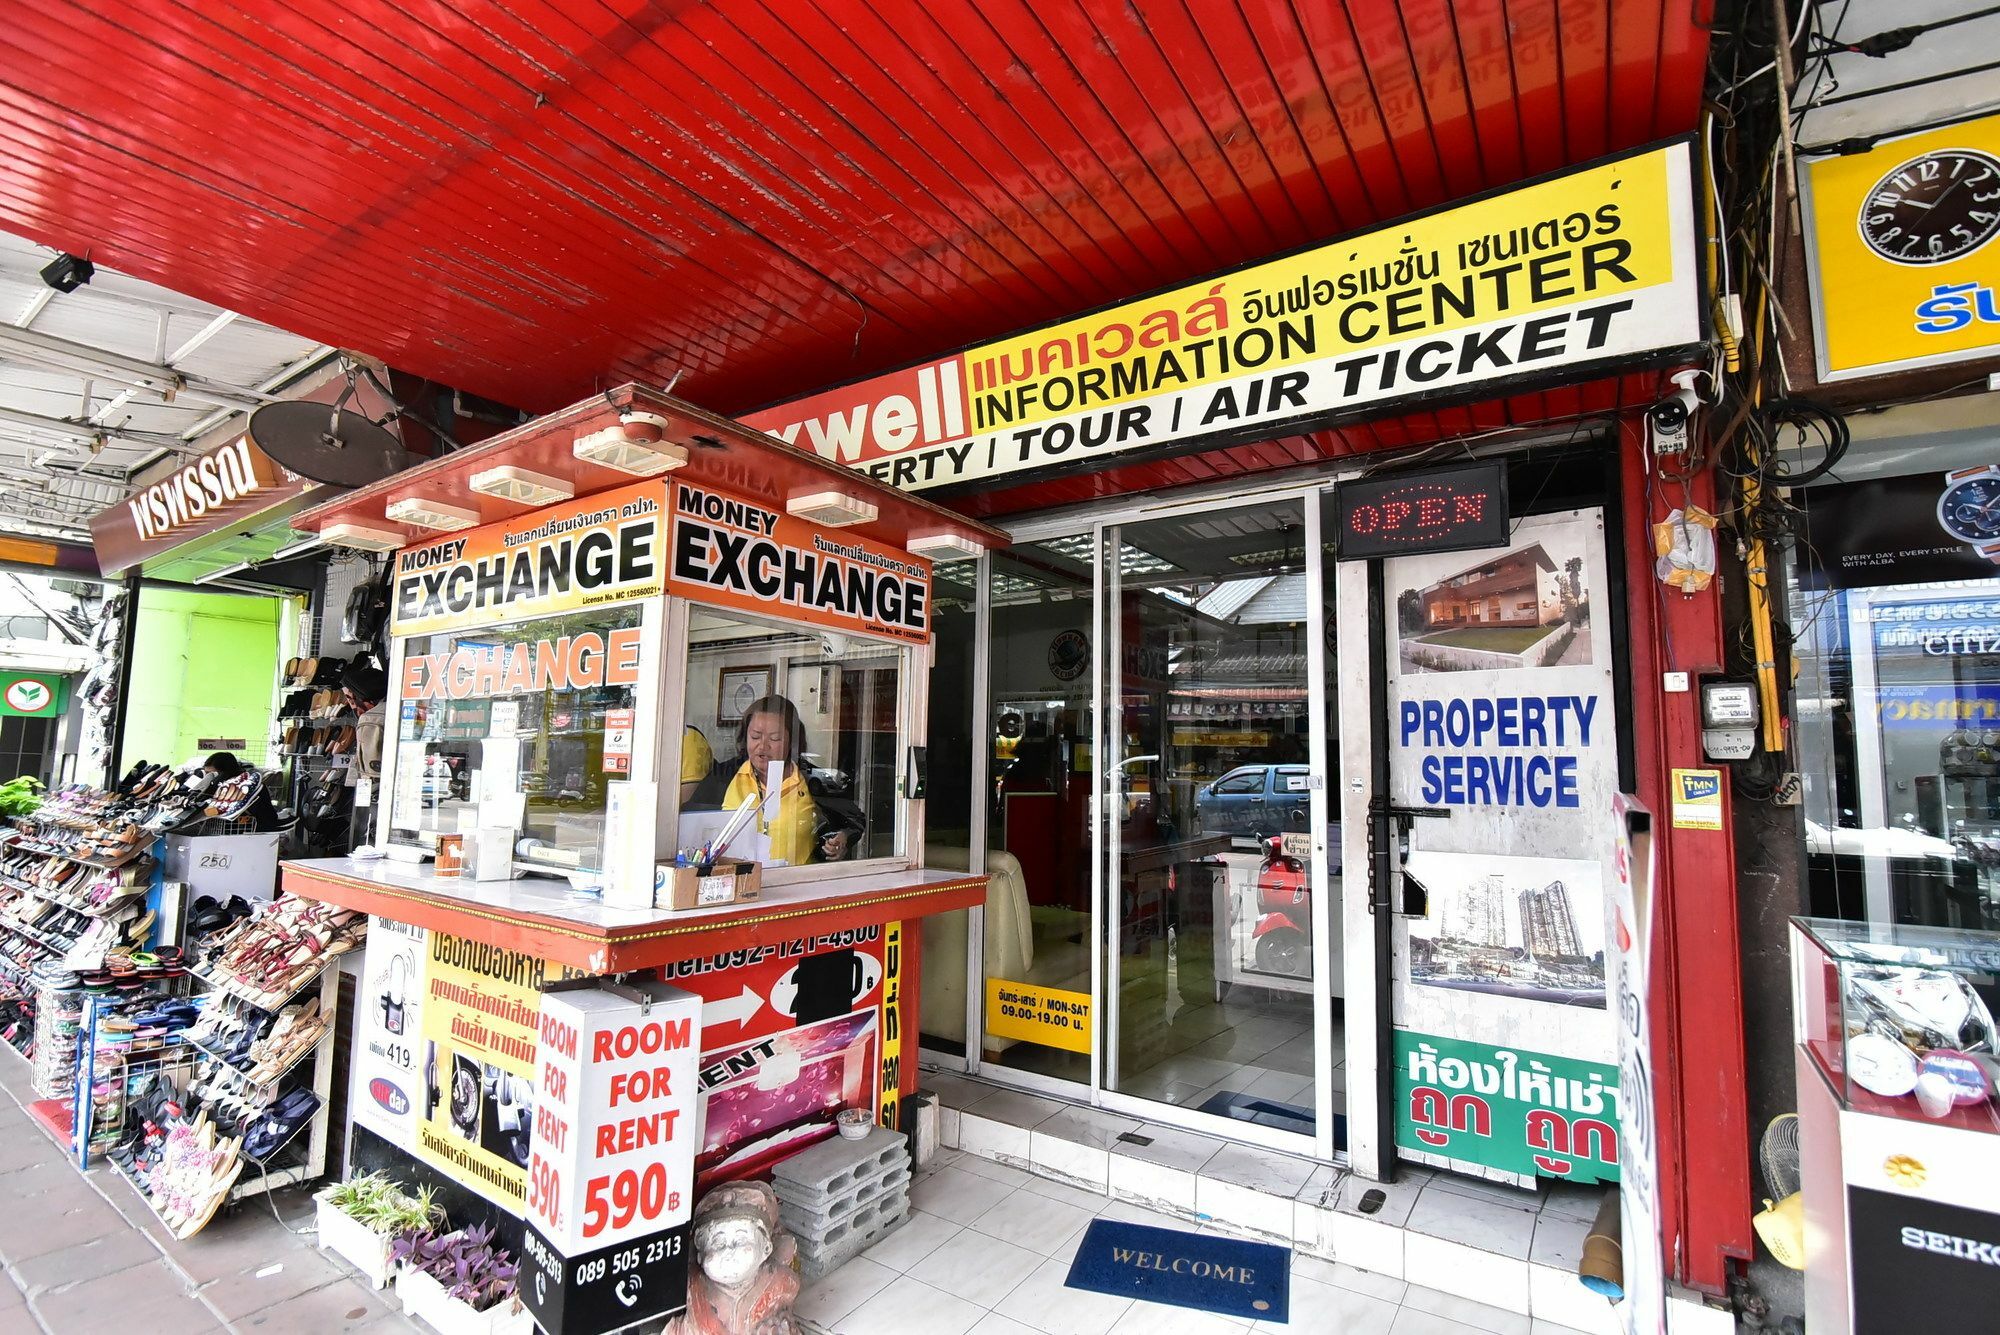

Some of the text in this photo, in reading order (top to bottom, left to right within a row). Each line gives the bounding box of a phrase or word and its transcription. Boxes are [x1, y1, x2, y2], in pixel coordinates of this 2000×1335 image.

[1891, 172, 1918, 192] 11
[1917, 161, 1940, 180] 12
[1950, 159, 1965, 179] 1
[1964, 168, 1992, 187] 2
[1873, 192, 1901, 209] 10
[1974, 188, 2000, 202] 3
[1870, 213, 1895, 226] 9
[1879, 226, 1902, 244] 8
[1950, 224, 1973, 243] 5
[1968, 211, 1997, 224] 4
[1243, 237, 1438, 323] อินฟอร์เมชั่น
[1459, 180, 1622, 270] เซนเตอร์
[1901, 235, 1920, 254] 7
[1928, 234, 1942, 254] 6
[974, 239, 1637, 429] INFORMATION CENTER
[1012, 405, 1152, 460] TOUR
[1200, 371, 1309, 425] AIR
[1334, 299, 1633, 397] TICKET
[128, 435, 259, 541] พรพรรณ
[679, 486, 778, 534] MONEY
[1352, 494, 1487, 533] OPEN
[397, 522, 655, 621] EXCHANGE
[401, 538, 467, 571] MONEY
[1843, 554, 1871, 562] EVERY
[1900, 549, 1930, 557] EVERY
[1933, 546, 1962, 554] STYLE
[1869, 558, 1895, 566] ALBA
[675, 521, 925, 628] EXCHANGE
[402, 629, 641, 699] EXCHANGE
[1401, 696, 1598, 747] PROPERTY
[1422, 756, 1580, 808] SERVICE
[1685, 780, 1713, 791] TMN
[1001, 1004, 1068, 1028] 09.00-19.00
[1047, 998, 1089, 1017] MON-SAT
[542, 1015, 579, 1061] ROOM
[592, 1018, 691, 1063] ROOM
[544, 1061, 567, 1104] FOR
[698, 1038, 775, 1094] ENT
[1408, 1043, 1622, 1120] ห้องให้เช่า
[609, 1067, 671, 1107] FOR
[537, 1104, 568, 1154] RENT
[596, 1109, 679, 1159] RENT
[1411, 1087, 1619, 1174] ถูก ถูก
[576, 1235, 681, 1286] 089 505 2313
[1112, 1246, 1256, 1285] WELCOME
